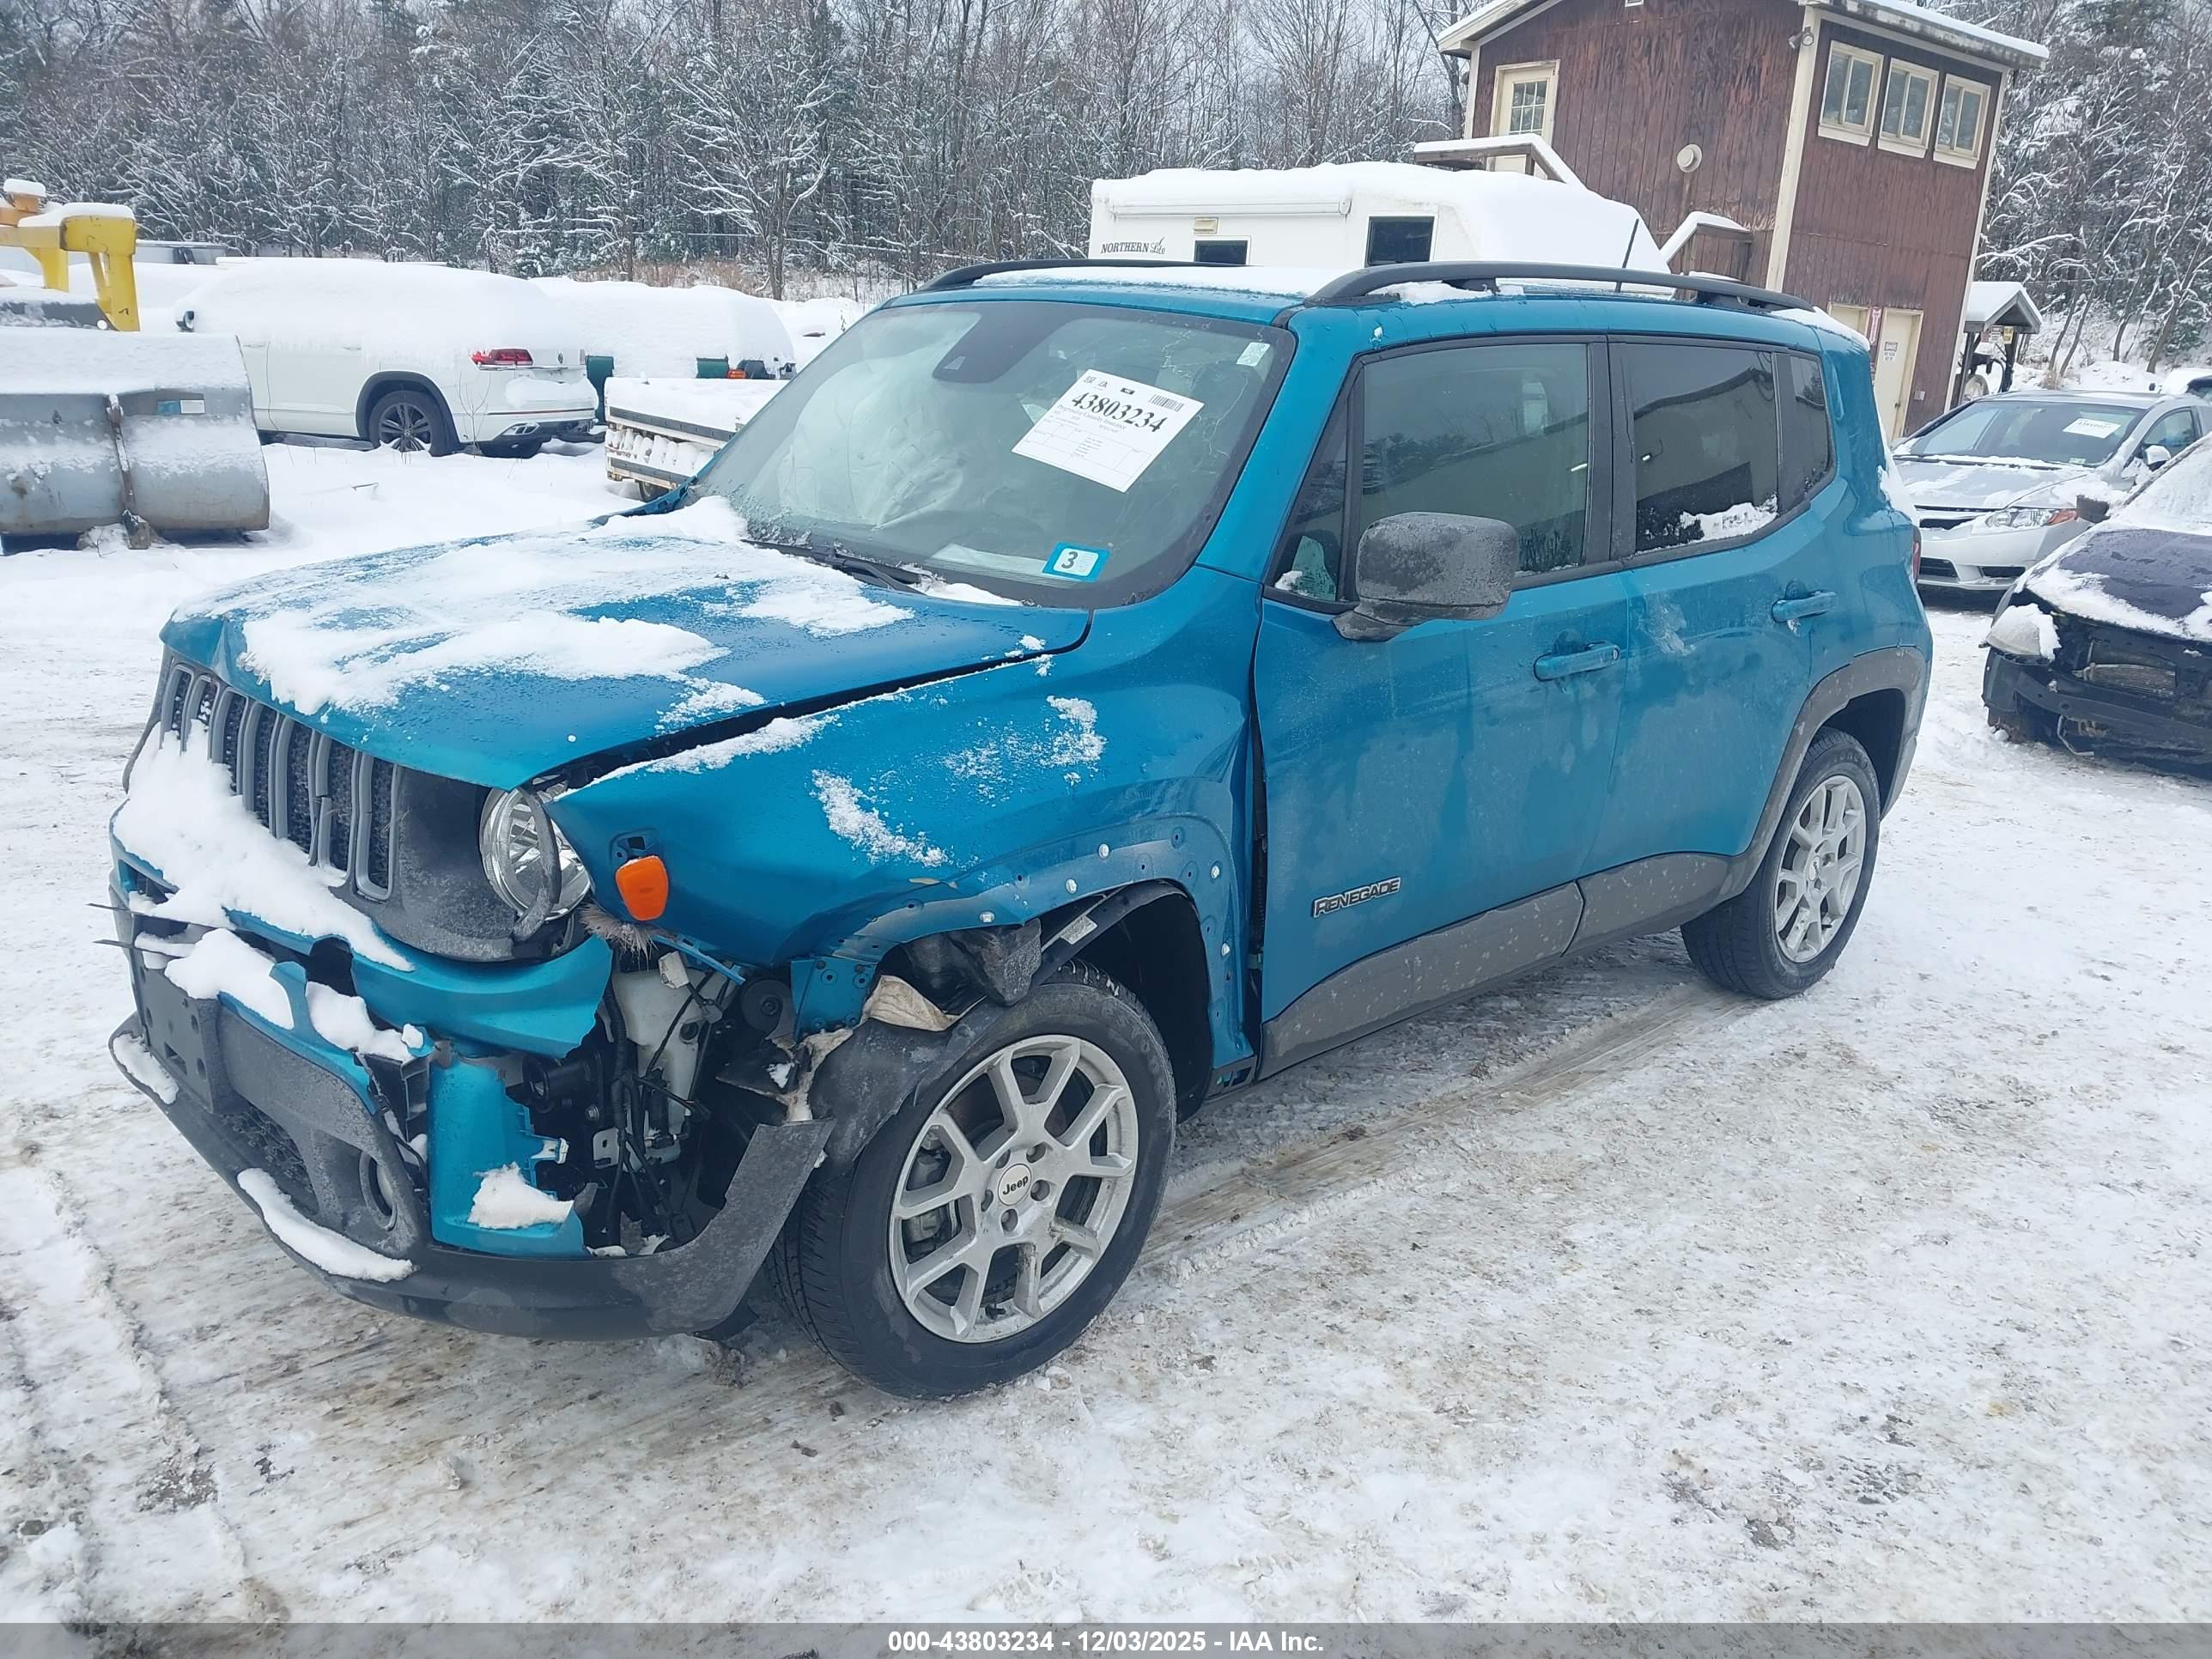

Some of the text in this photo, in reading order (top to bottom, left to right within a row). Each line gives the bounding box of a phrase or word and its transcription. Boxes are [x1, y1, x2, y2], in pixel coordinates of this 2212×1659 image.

[1100, 241, 1150, 254] NORTHERN
[1071, 392, 1168, 433] 43803234
[1060, 550, 1079, 569] 3
[1312, 877, 1401, 918] RENEGADE
[1002, 1176, 1029, 1195] Jeep
